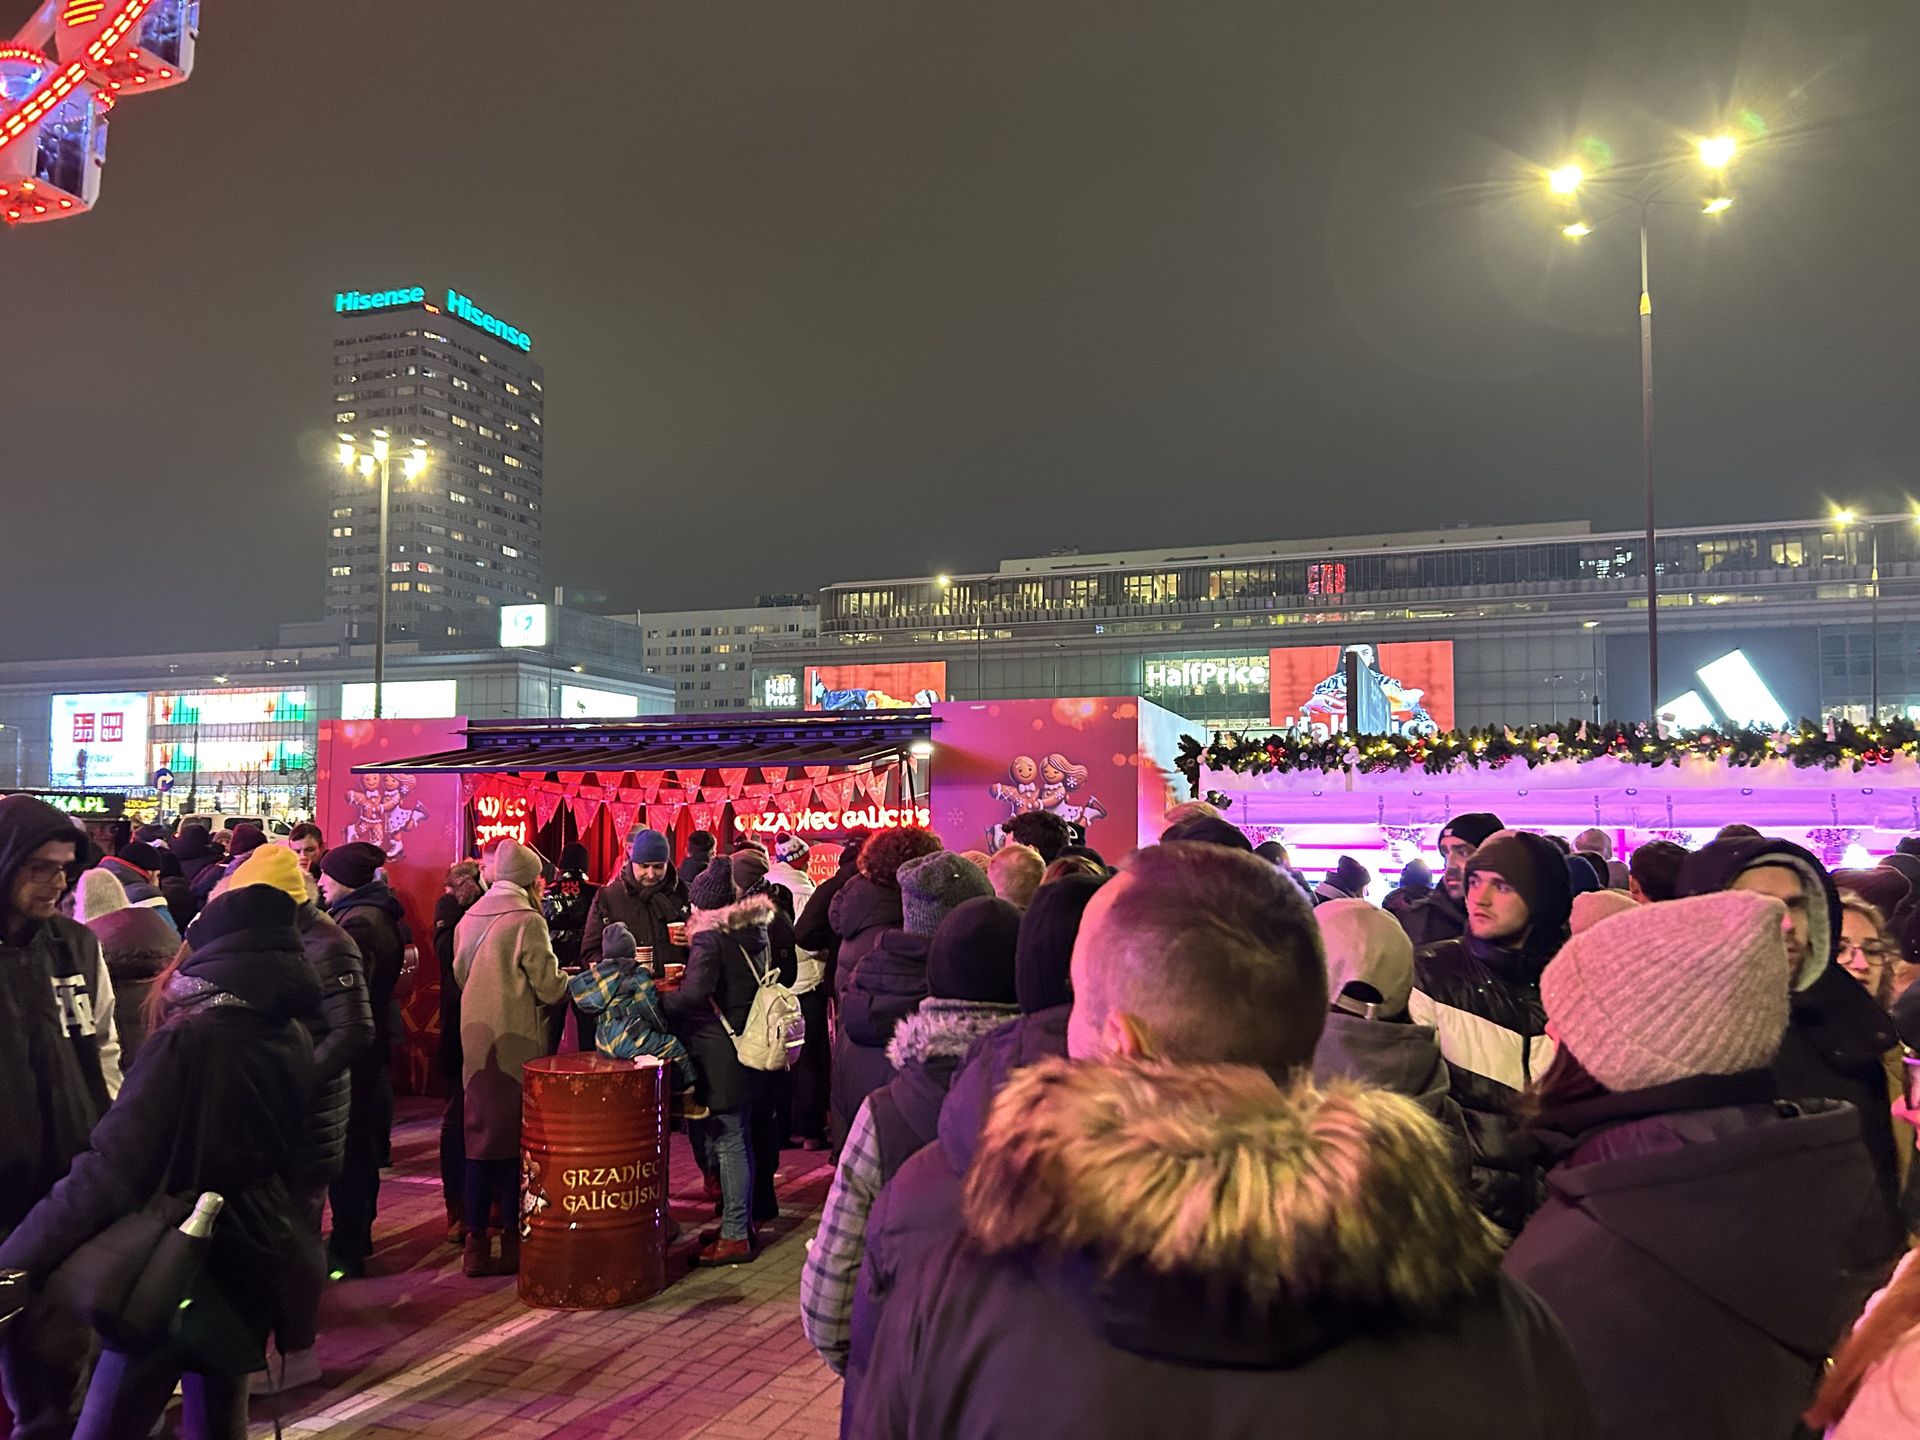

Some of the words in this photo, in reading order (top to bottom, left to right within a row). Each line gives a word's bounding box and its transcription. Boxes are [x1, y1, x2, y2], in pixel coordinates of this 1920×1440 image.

[335, 286, 425, 313] Hisense
[447, 288, 531, 352] Hisense
[1147, 662, 1268, 688] HalfPrice
[765, 677, 796, 694] Half
[765, 692, 797, 706] Price
[102, 715, 121, 727] UNI
[102, 728, 122, 740] QLO
